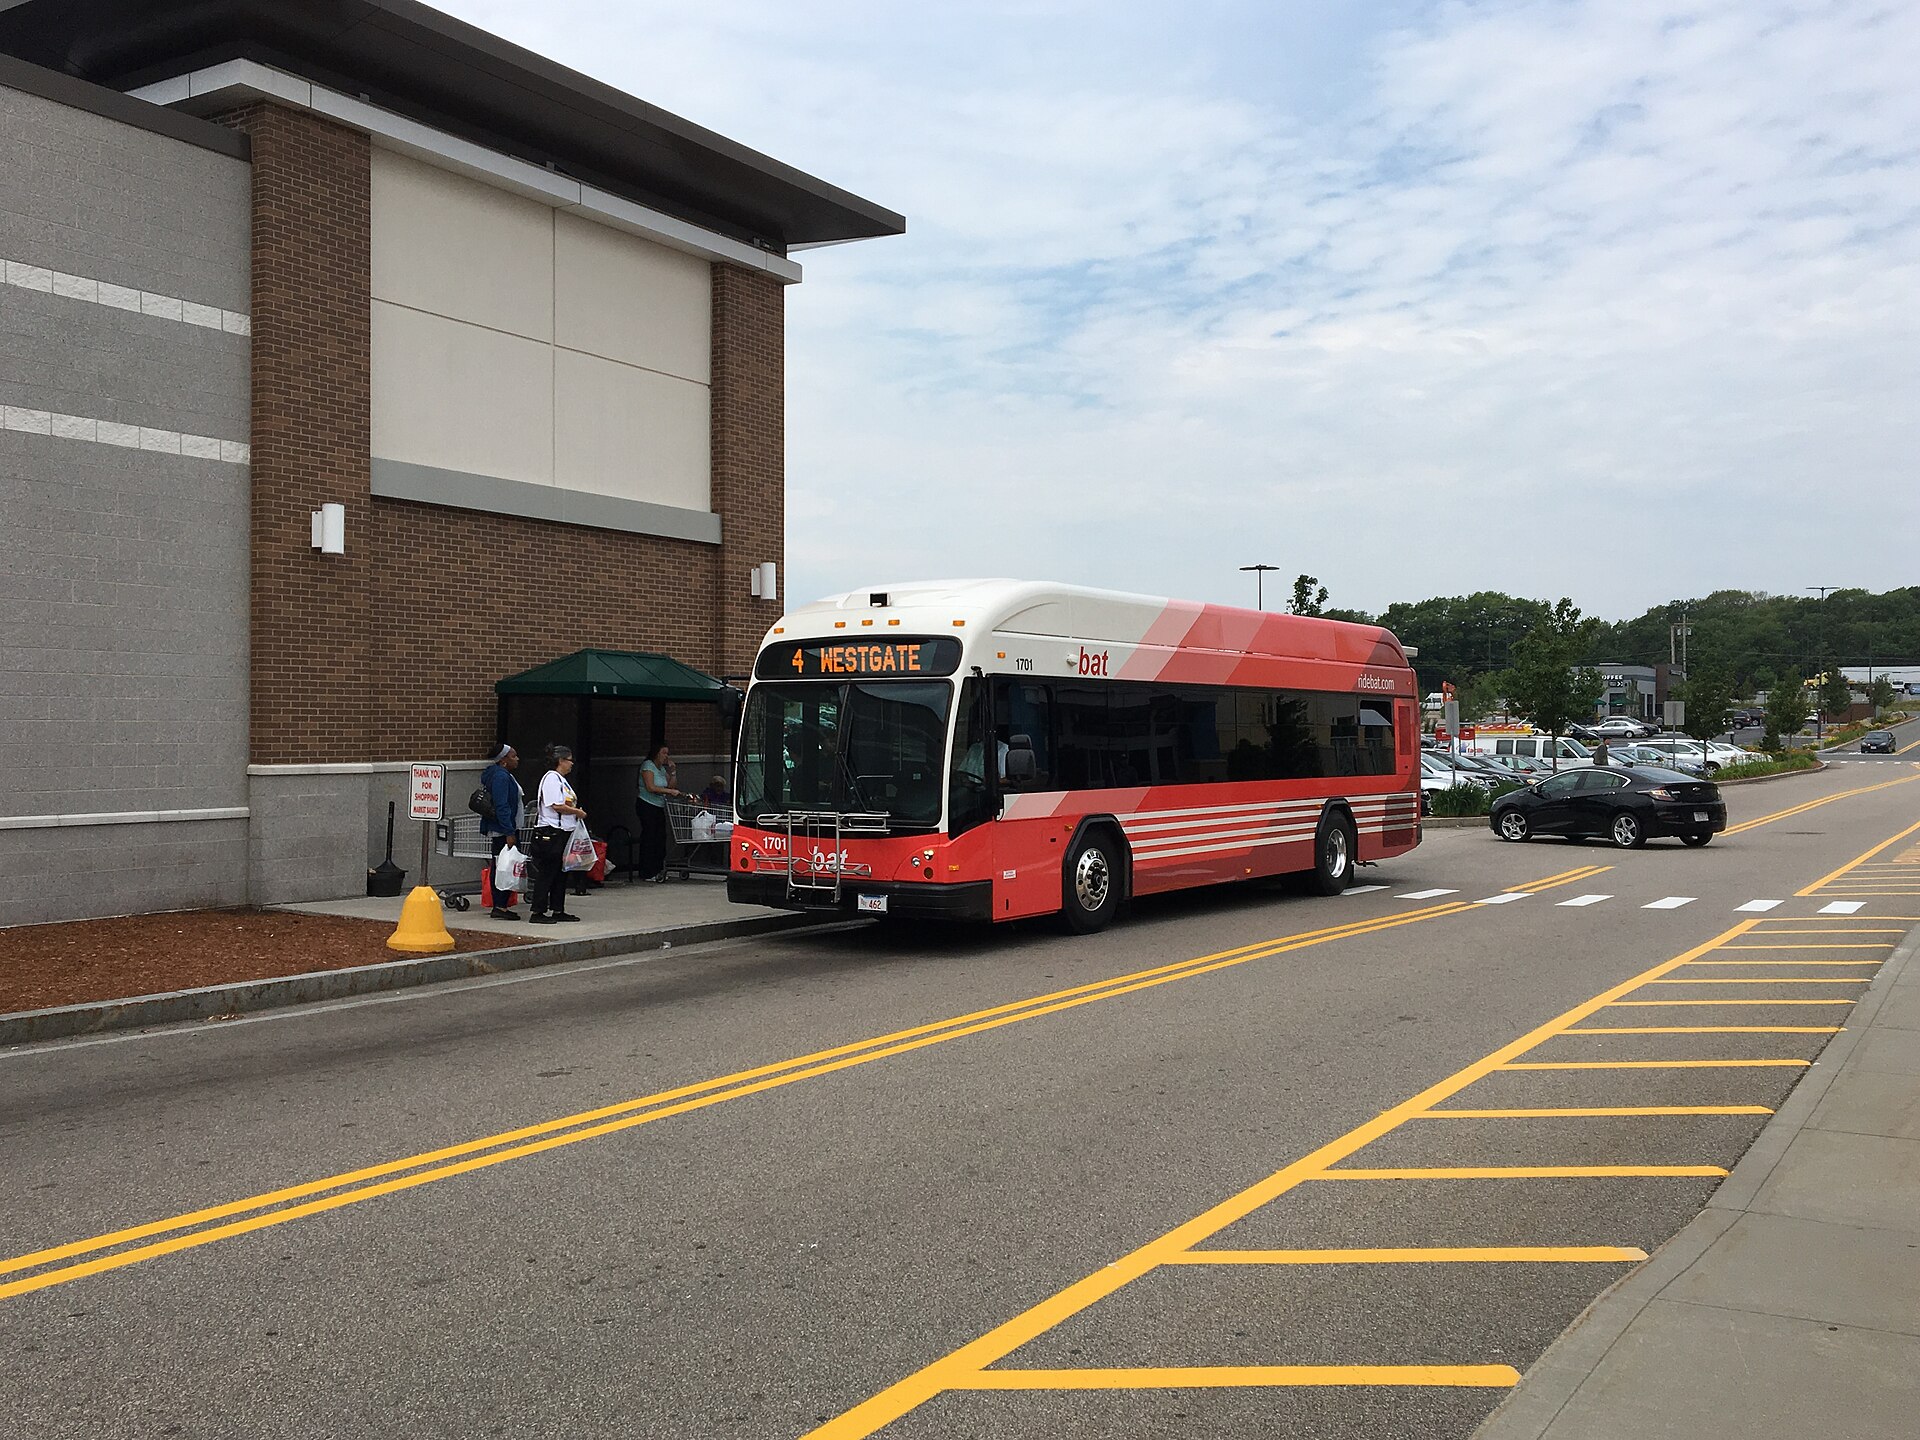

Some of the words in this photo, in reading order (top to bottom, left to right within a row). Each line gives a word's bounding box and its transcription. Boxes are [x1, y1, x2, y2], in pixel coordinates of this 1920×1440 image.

[792, 648, 804, 673] 4
[820, 644, 921, 673] WESTGATE
[1015, 658, 1033, 671] 1701
[1078, 646, 1109, 676] bat
[1358, 673, 1394, 689] ridebat.com
[414, 769, 429, 778] THANK
[430, 770, 440, 778] YOU
[414, 793, 438, 801] SHOPPING
[763, 837, 787, 850] 1701
[811, 846, 848, 871] bat
[868, 899, 882, 910] 462
